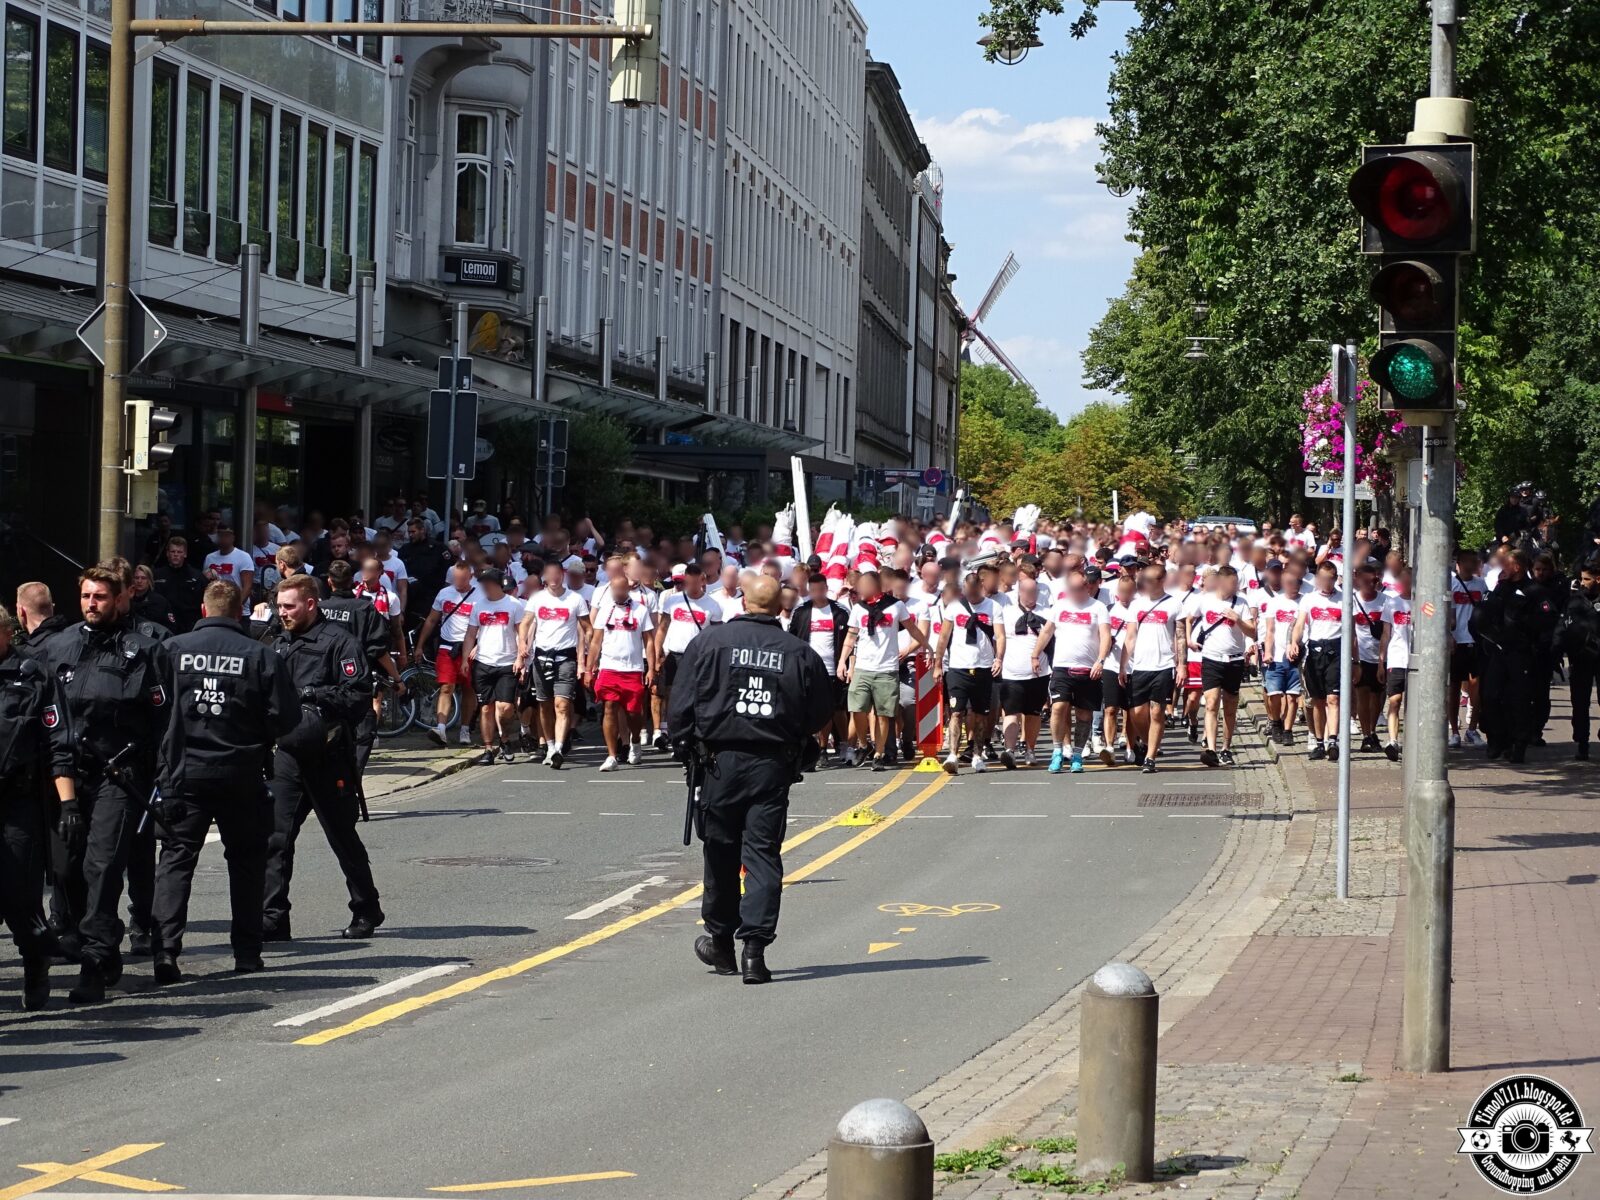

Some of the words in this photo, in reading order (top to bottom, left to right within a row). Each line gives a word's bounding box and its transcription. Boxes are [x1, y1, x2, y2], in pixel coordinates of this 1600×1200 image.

[463, 262, 495, 276] Lemon
[180, 653, 244, 675] POLIZEI
[731, 648, 783, 670] POLIZEI
[203, 677, 217, 690] NI
[748, 676, 763, 689] NI
[194, 689, 225, 703] 7423
[738, 688, 771, 703] 7420
